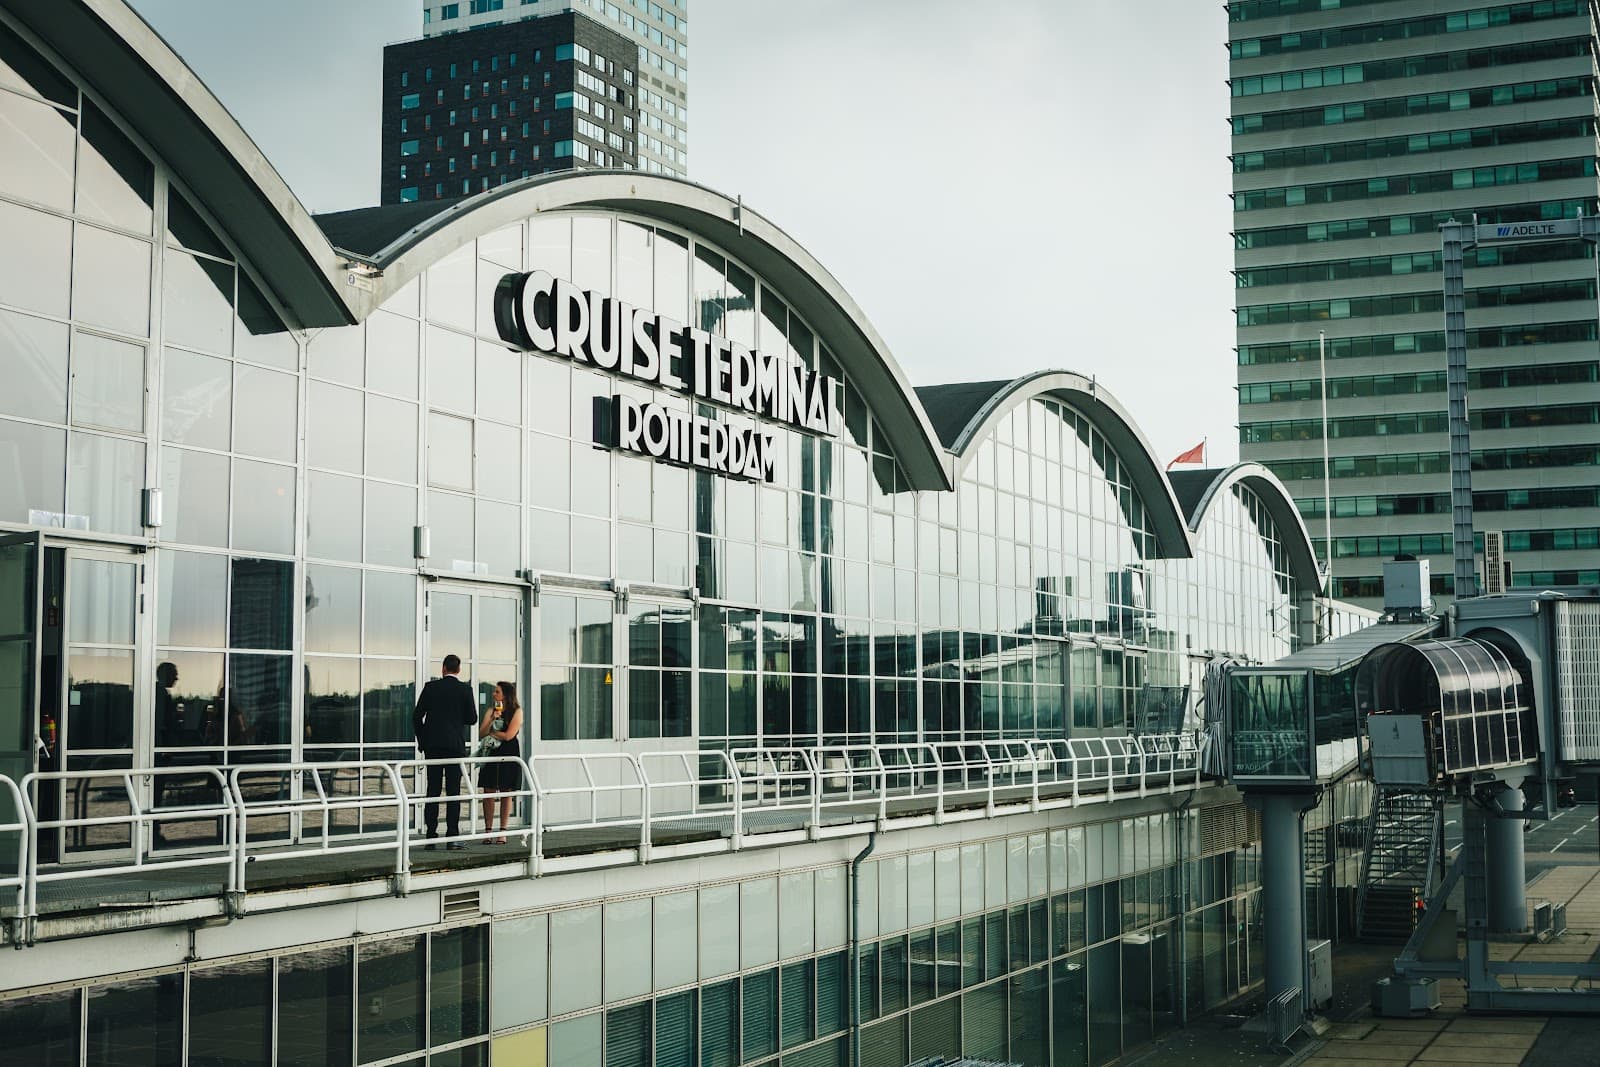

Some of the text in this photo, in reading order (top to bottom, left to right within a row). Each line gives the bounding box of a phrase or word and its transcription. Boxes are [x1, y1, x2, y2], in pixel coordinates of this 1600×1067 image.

[1511, 224, 1556, 236] ADELTE
[521, 269, 840, 437] CRUISE TERMINAL
[618, 394, 778, 483] ROTTERDAM
